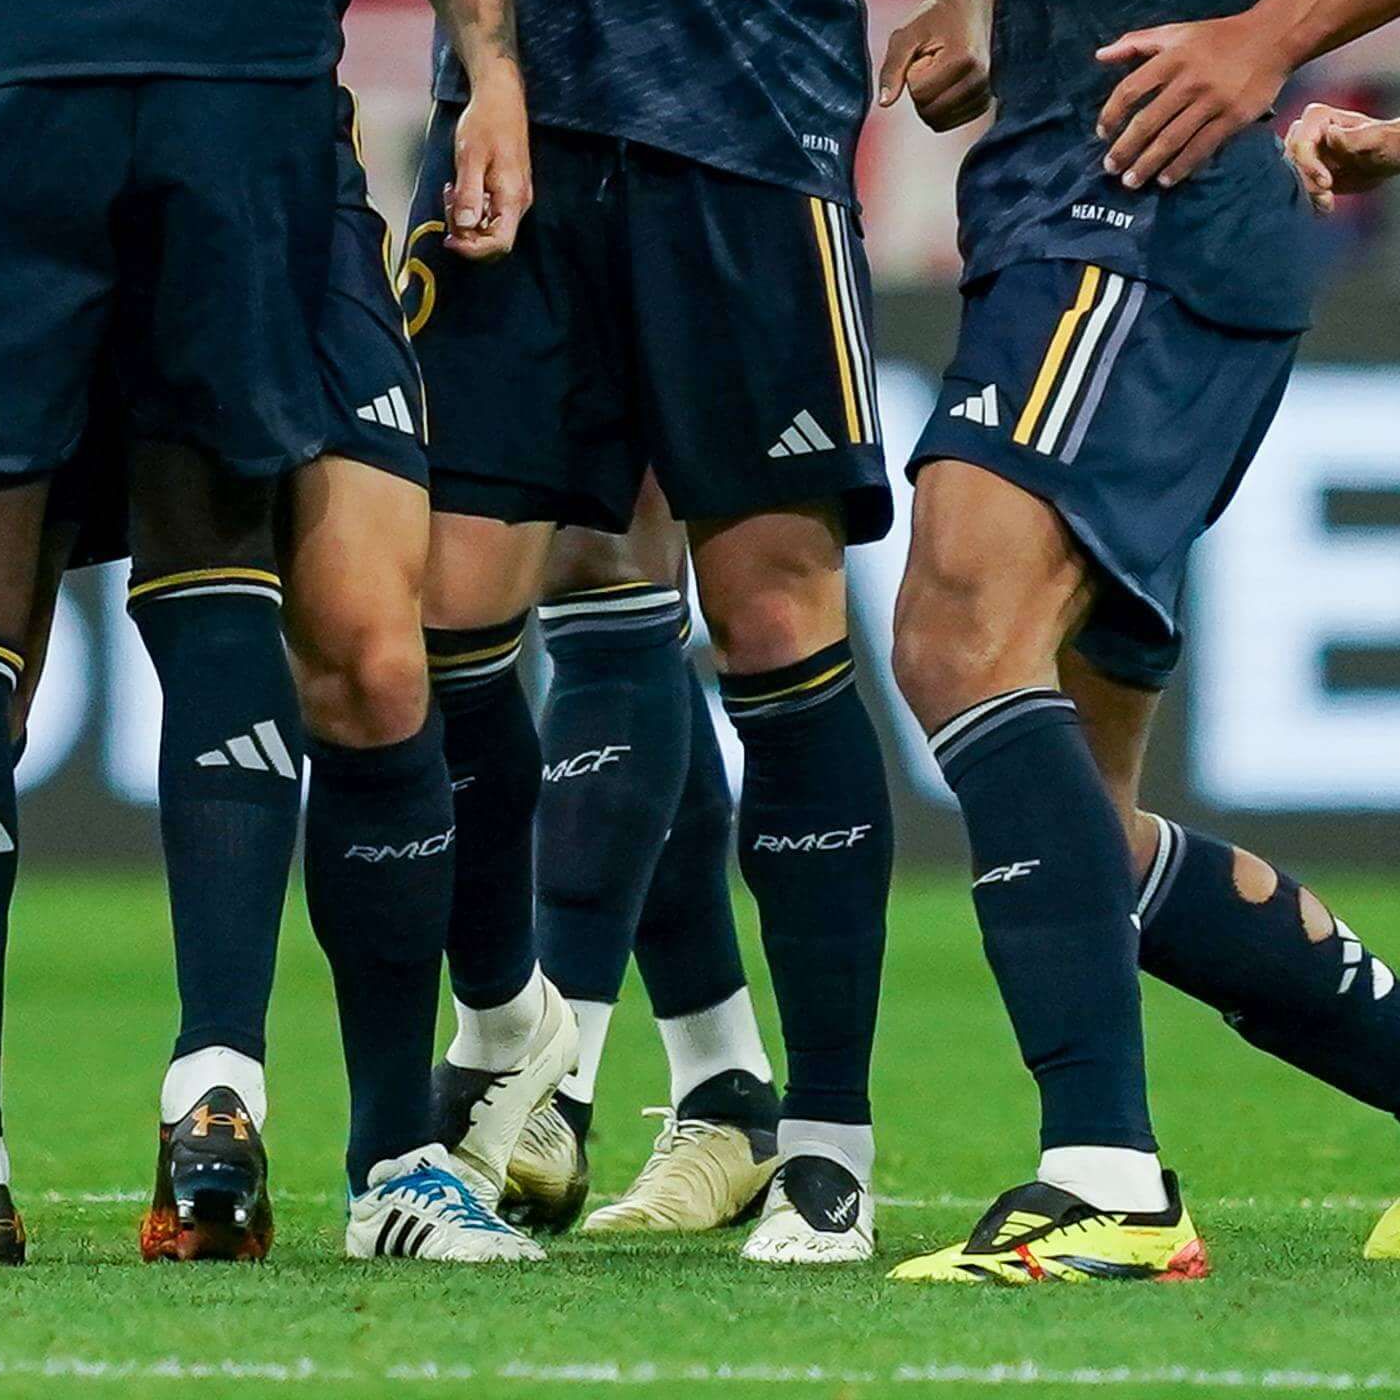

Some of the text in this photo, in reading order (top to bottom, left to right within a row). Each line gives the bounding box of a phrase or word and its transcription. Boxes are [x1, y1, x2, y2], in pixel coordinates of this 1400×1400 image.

[541, 745, 632, 783] MCF
[753, 824, 872, 852] RMCF
[972, 859, 1041, 889] CF
